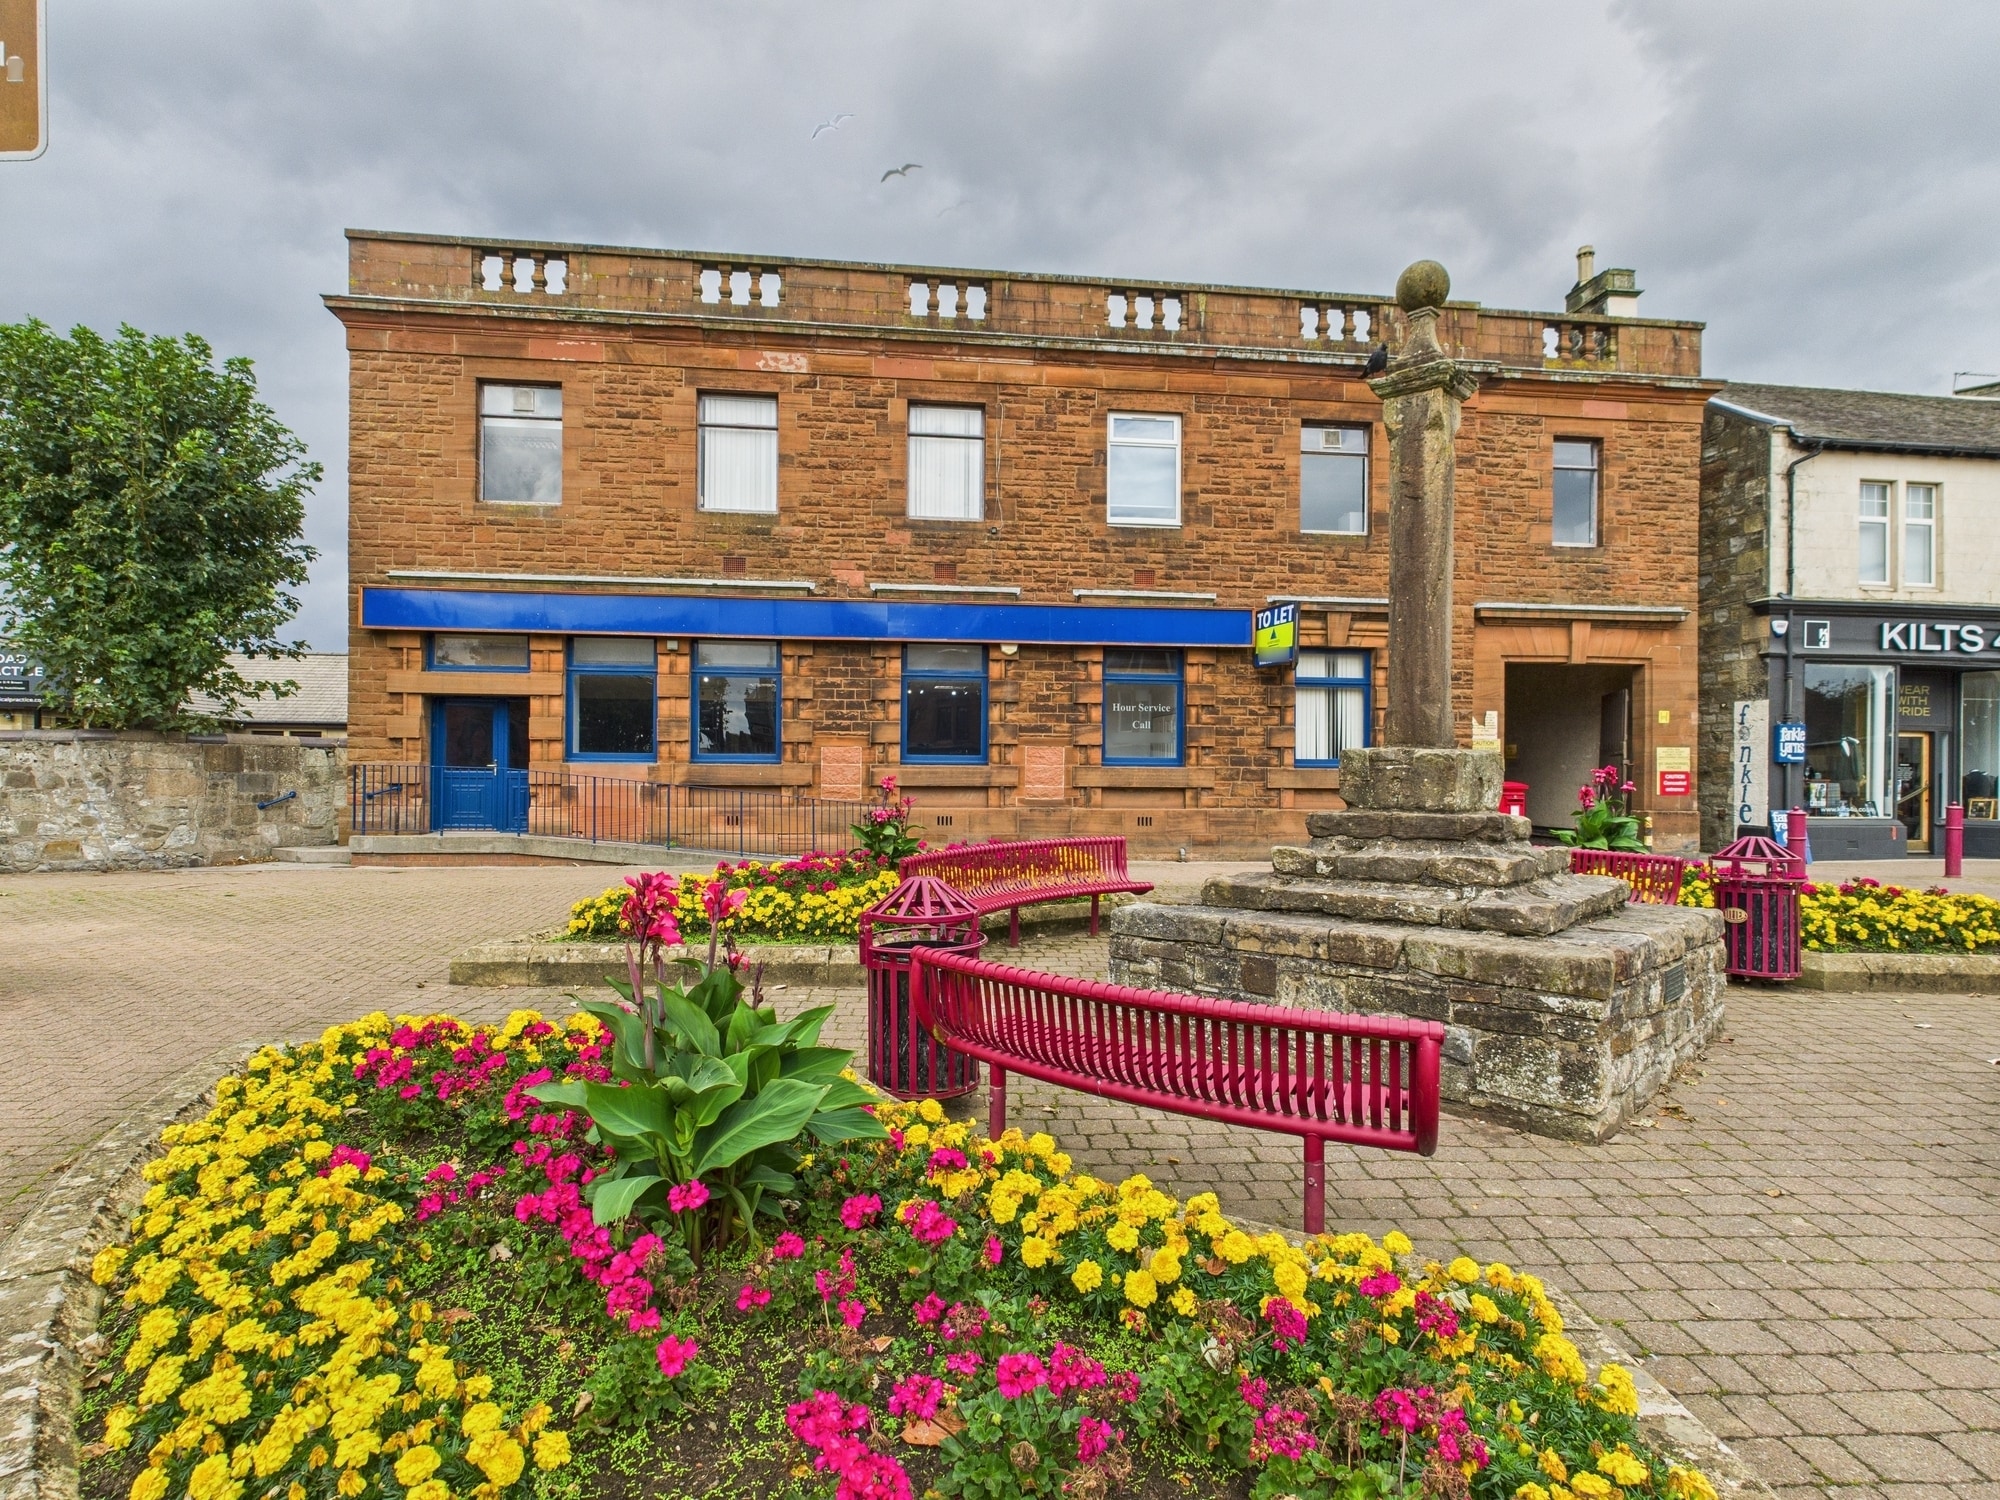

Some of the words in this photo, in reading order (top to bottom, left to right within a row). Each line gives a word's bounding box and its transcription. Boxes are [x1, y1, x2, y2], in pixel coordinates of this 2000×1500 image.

[1257, 610, 1271, 629] TO
[1273, 604, 1294, 625] LET
[1882, 622, 1985, 652] KILTS
[1112, 702, 1136, 712] Hour
[1138, 703, 1171, 712] Service
[1132, 720, 1151, 730] Call
[1780, 742, 1805, 757] yarns
